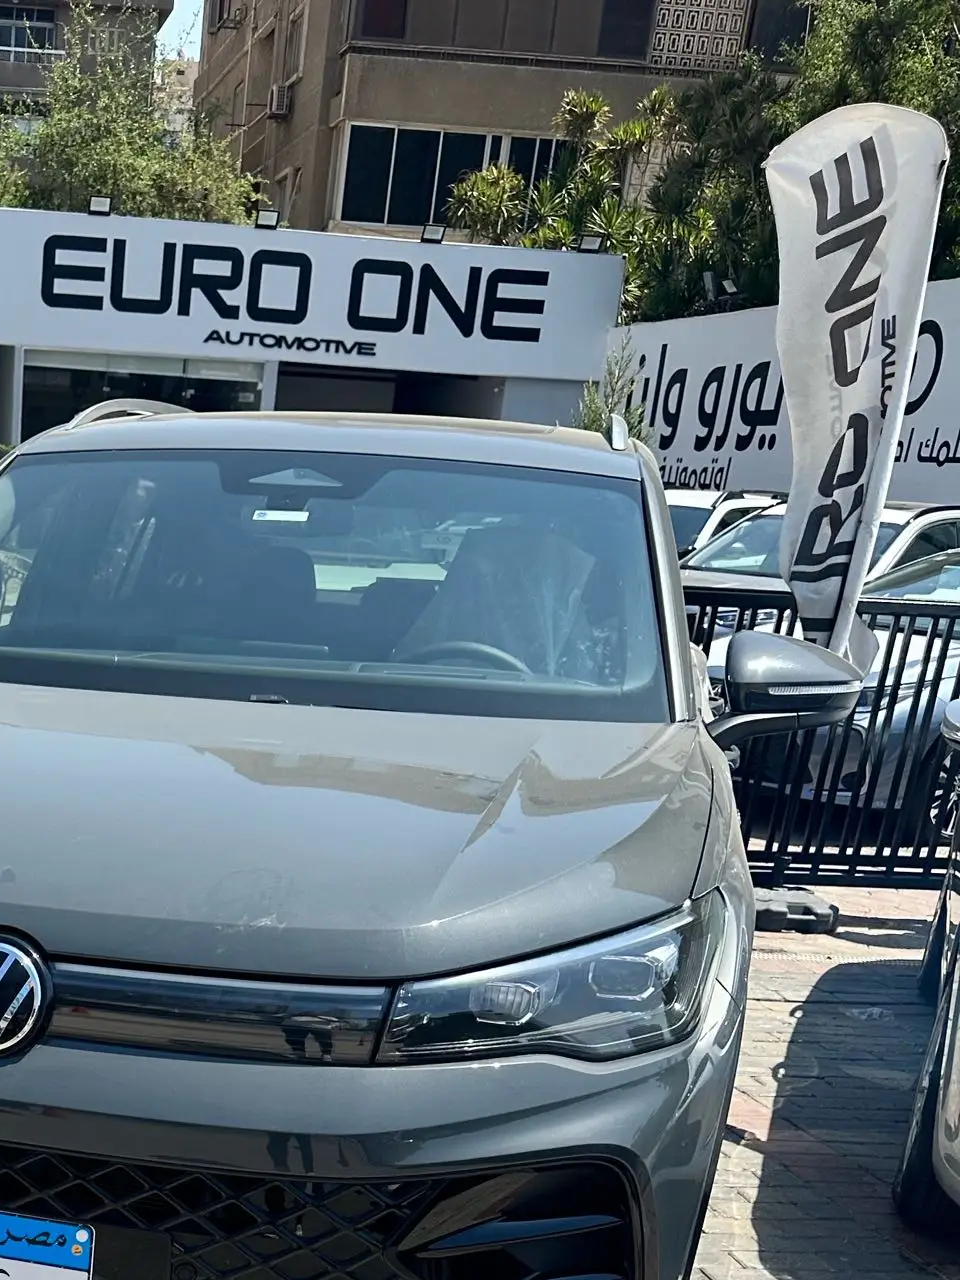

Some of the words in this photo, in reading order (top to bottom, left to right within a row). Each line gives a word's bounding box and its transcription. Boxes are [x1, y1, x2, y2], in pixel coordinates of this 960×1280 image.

[41, 234, 312, 325] EURO
[347, 258, 550, 343] ONE
[809, 135, 887, 388] ONE
[202, 328, 376, 356] AUTOMOTIVE
[693, 361, 784, 452] يورو
